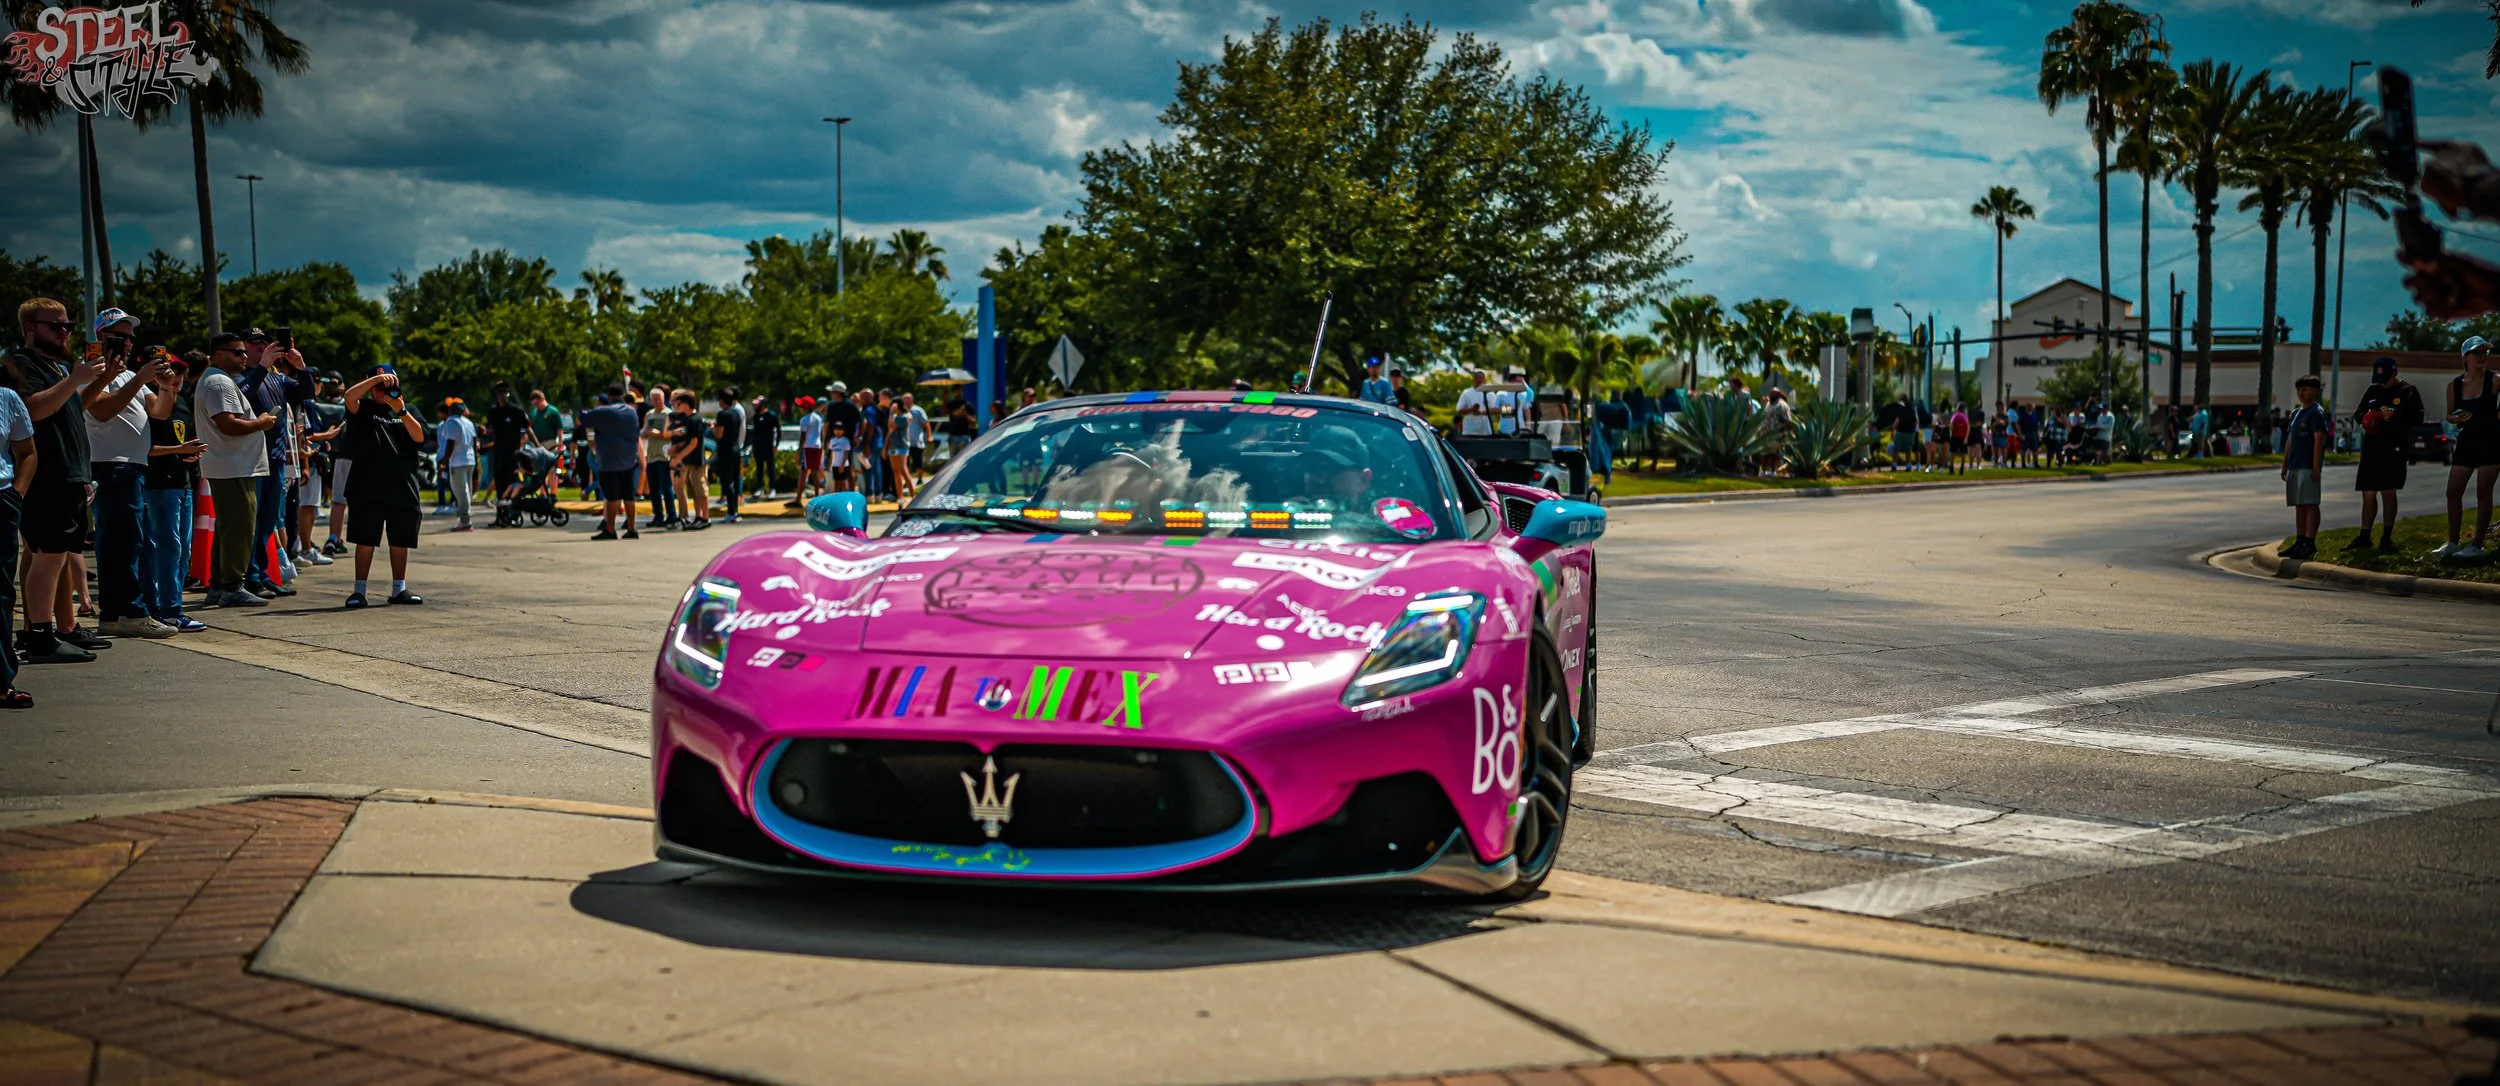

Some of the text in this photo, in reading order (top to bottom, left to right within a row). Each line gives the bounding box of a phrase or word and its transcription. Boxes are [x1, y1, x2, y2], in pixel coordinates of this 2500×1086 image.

[1252, 556, 1362, 582] Leno
[712, 605, 812, 633] Hard
[1295, 614, 1385, 643] Rock
[1012, 665, 1160, 729] MEX
